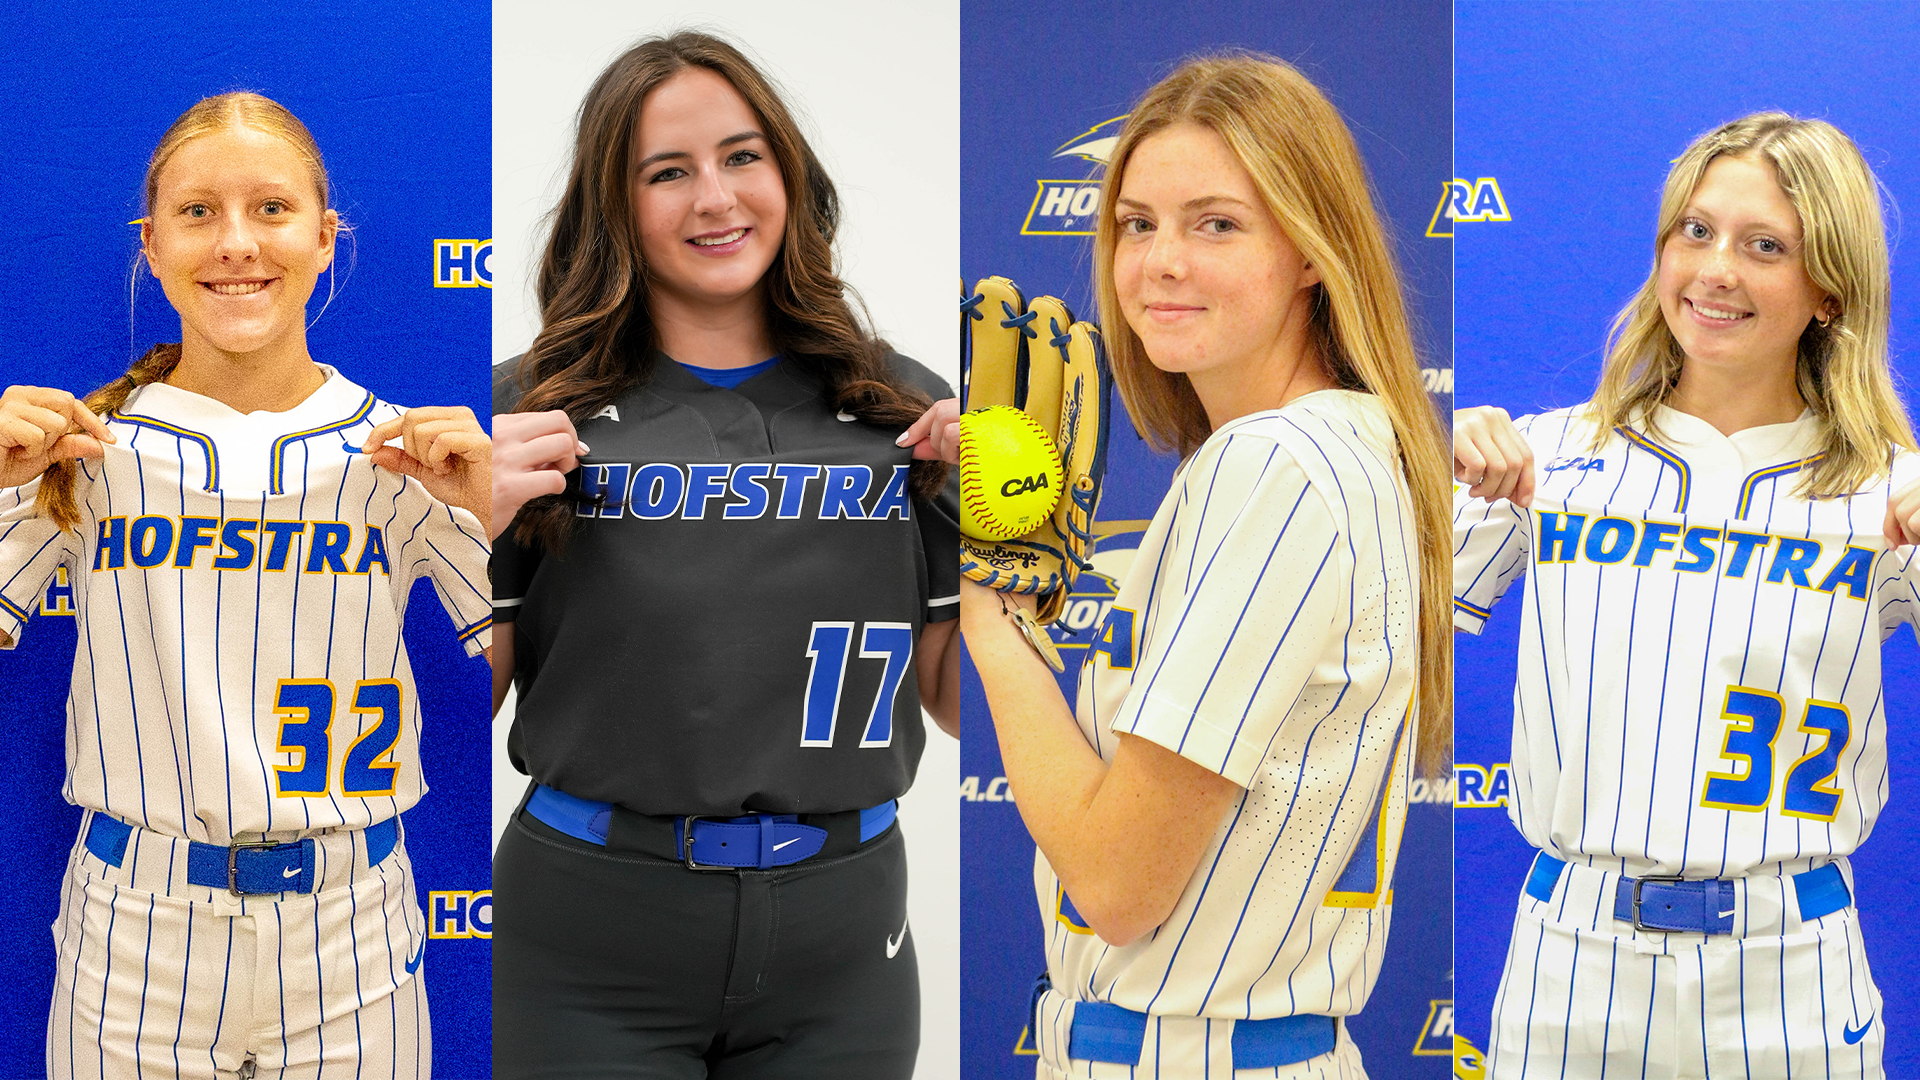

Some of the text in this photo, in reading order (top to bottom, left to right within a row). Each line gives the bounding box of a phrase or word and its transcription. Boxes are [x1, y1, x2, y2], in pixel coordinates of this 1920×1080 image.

[1040, 187, 1101, 216] HO
[576, 463, 911, 520] HOFSTRA
[1001, 472, 1049, 497] CAA
[92, 514, 390, 576] HOFSTRA
[962, 541, 1040, 569] Rawlings
[1535, 509, 1878, 602] HOFSTRA
[800, 621, 913, 748] 17
[272, 677, 403, 798] 32
[1700, 684, 1852, 823] 32
[1454, 763, 1509, 808] RA
